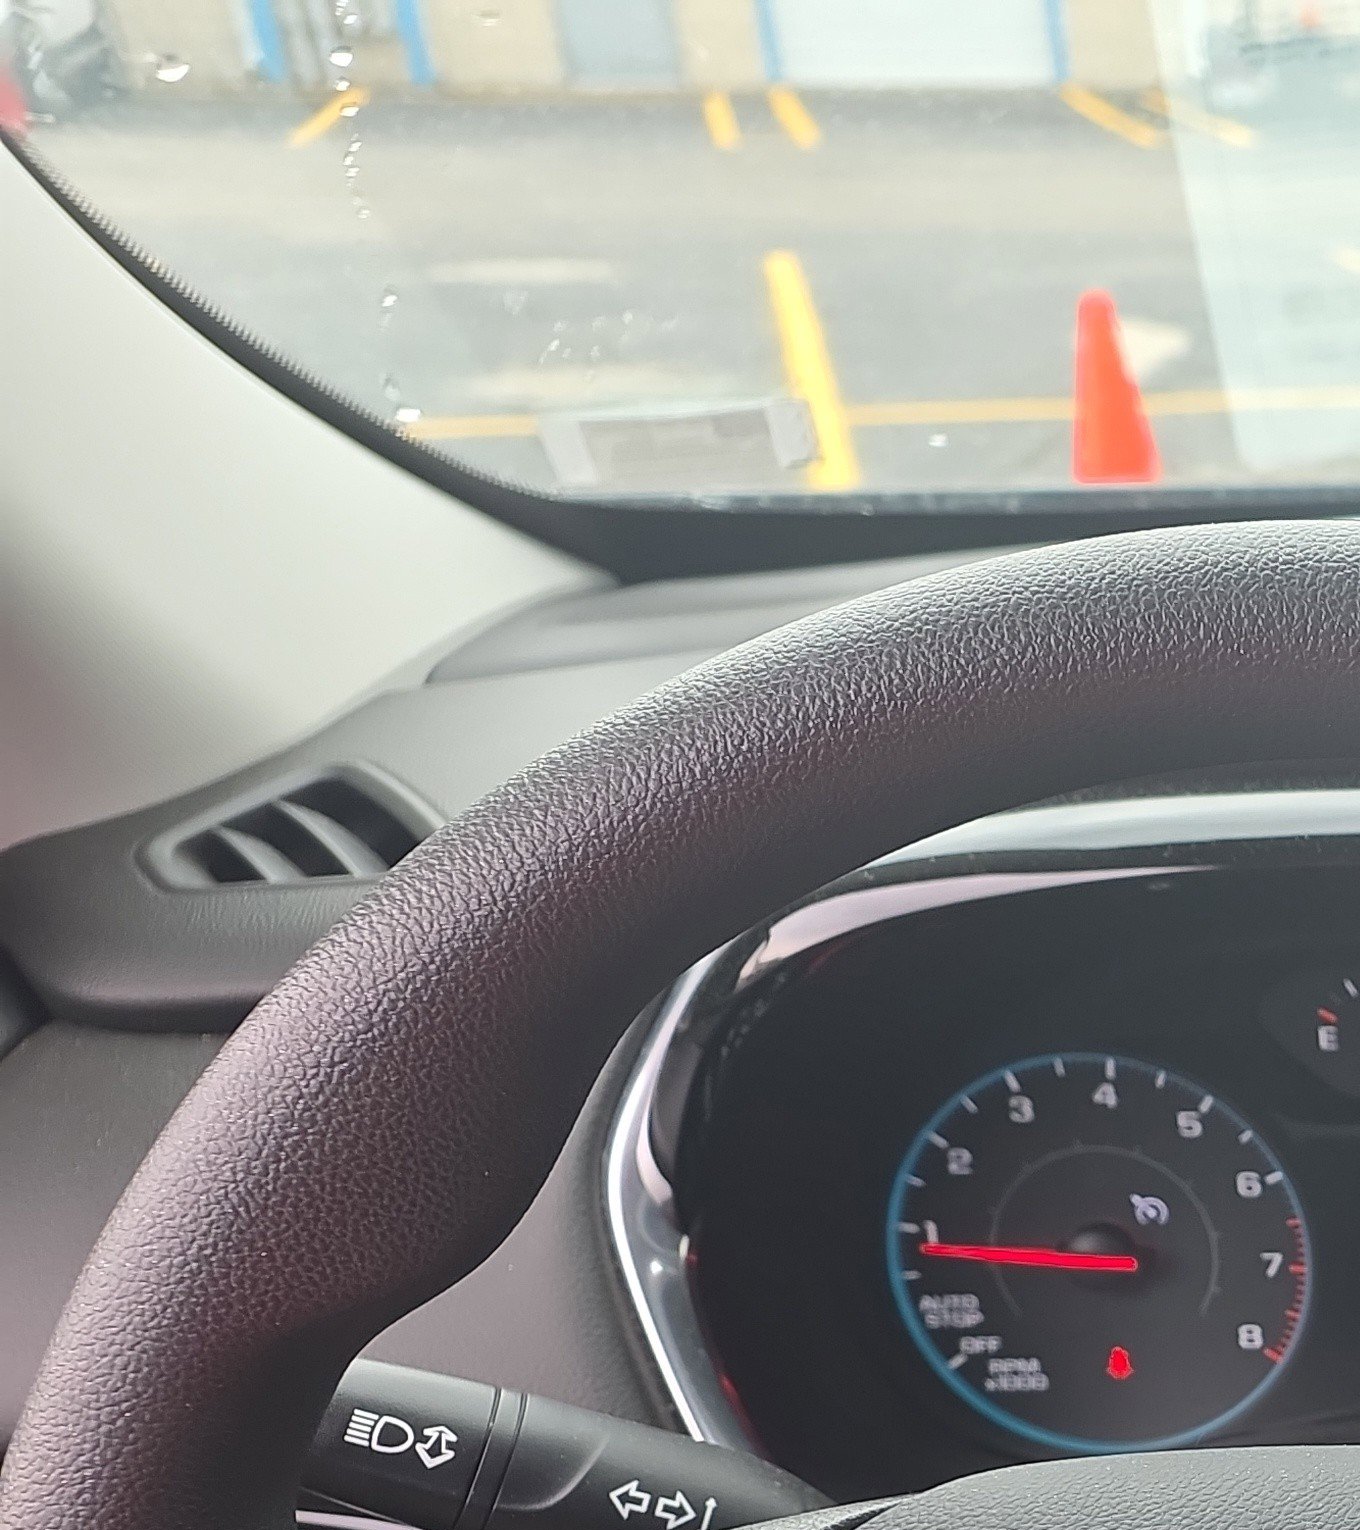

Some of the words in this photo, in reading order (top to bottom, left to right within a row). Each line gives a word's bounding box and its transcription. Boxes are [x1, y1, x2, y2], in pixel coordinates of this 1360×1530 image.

[1317, 1025, 1340, 1052] E
[1008, 1094, 1035, 1123] 3
[1092, 1081, 1118, 1108] 4
[1175, 1110, 1203, 1139] 5
[946, 1146, 972, 1176] 2
[1235, 1170, 1263, 1199] 6
[1260, 1251, 1284, 1278] 7
[1237, 1323, 1264, 1349] 8
